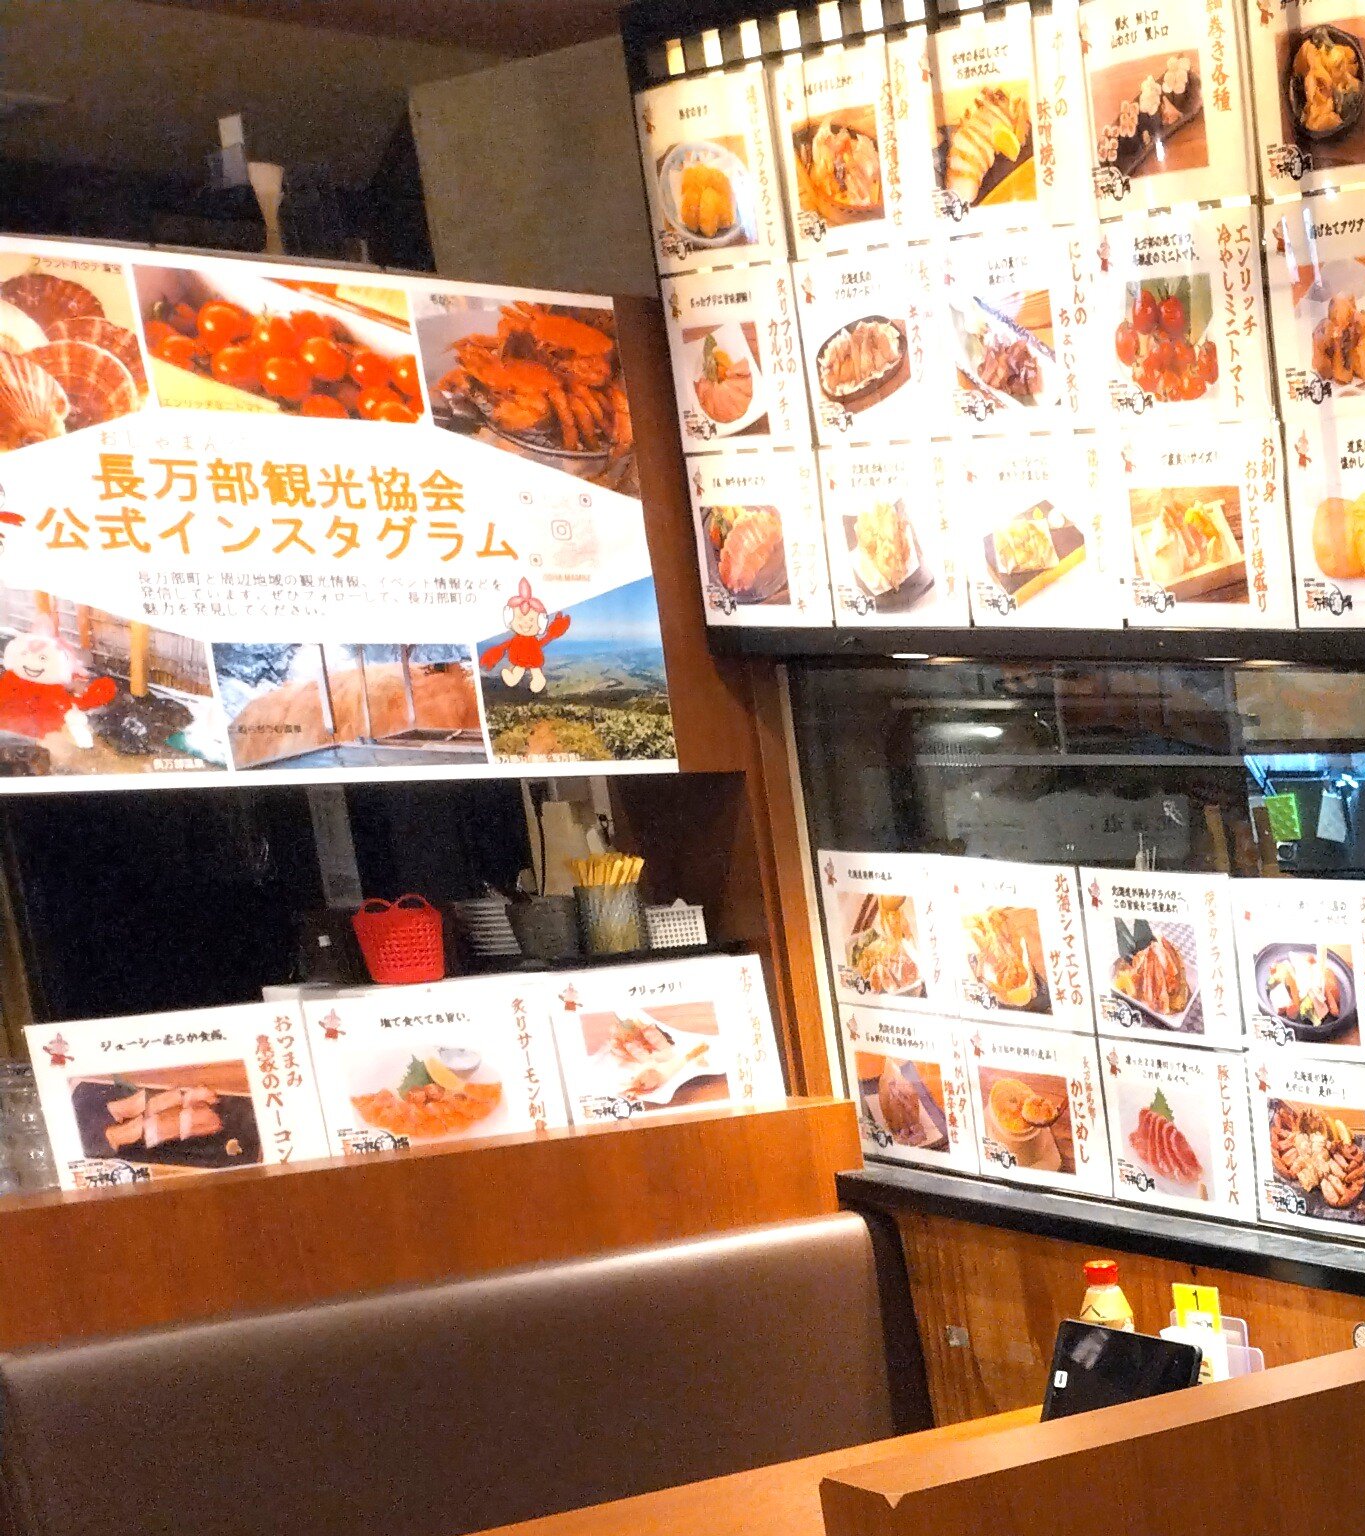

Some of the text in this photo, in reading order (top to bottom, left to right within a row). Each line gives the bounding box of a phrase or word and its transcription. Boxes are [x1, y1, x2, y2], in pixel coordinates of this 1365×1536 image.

[1216, 223, 1245, 410] 冷やしミニトマト
[1235, 223, 1258, 338] エンリッチ
[91, 452, 466, 514] 長万部観光協会
[1260, 437, 1277, 503] お刺身
[35, 505, 520, 562] 公式インスタグラム
[1245, 460, 1268, 613] おひとり様盛り
[1049, 949, 1068, 1006] ザンギ
[1204, 890, 1227, 1017] 焼きタラバガニ
[255, 1034, 293, 1165] 農家のベーコン
[273, 1015, 303, 1088] おつまみ
[1070, 1079, 1090, 1164] かにめし
[1217, 1064, 1239, 1205] 豚ヒレ肉のルイベ
